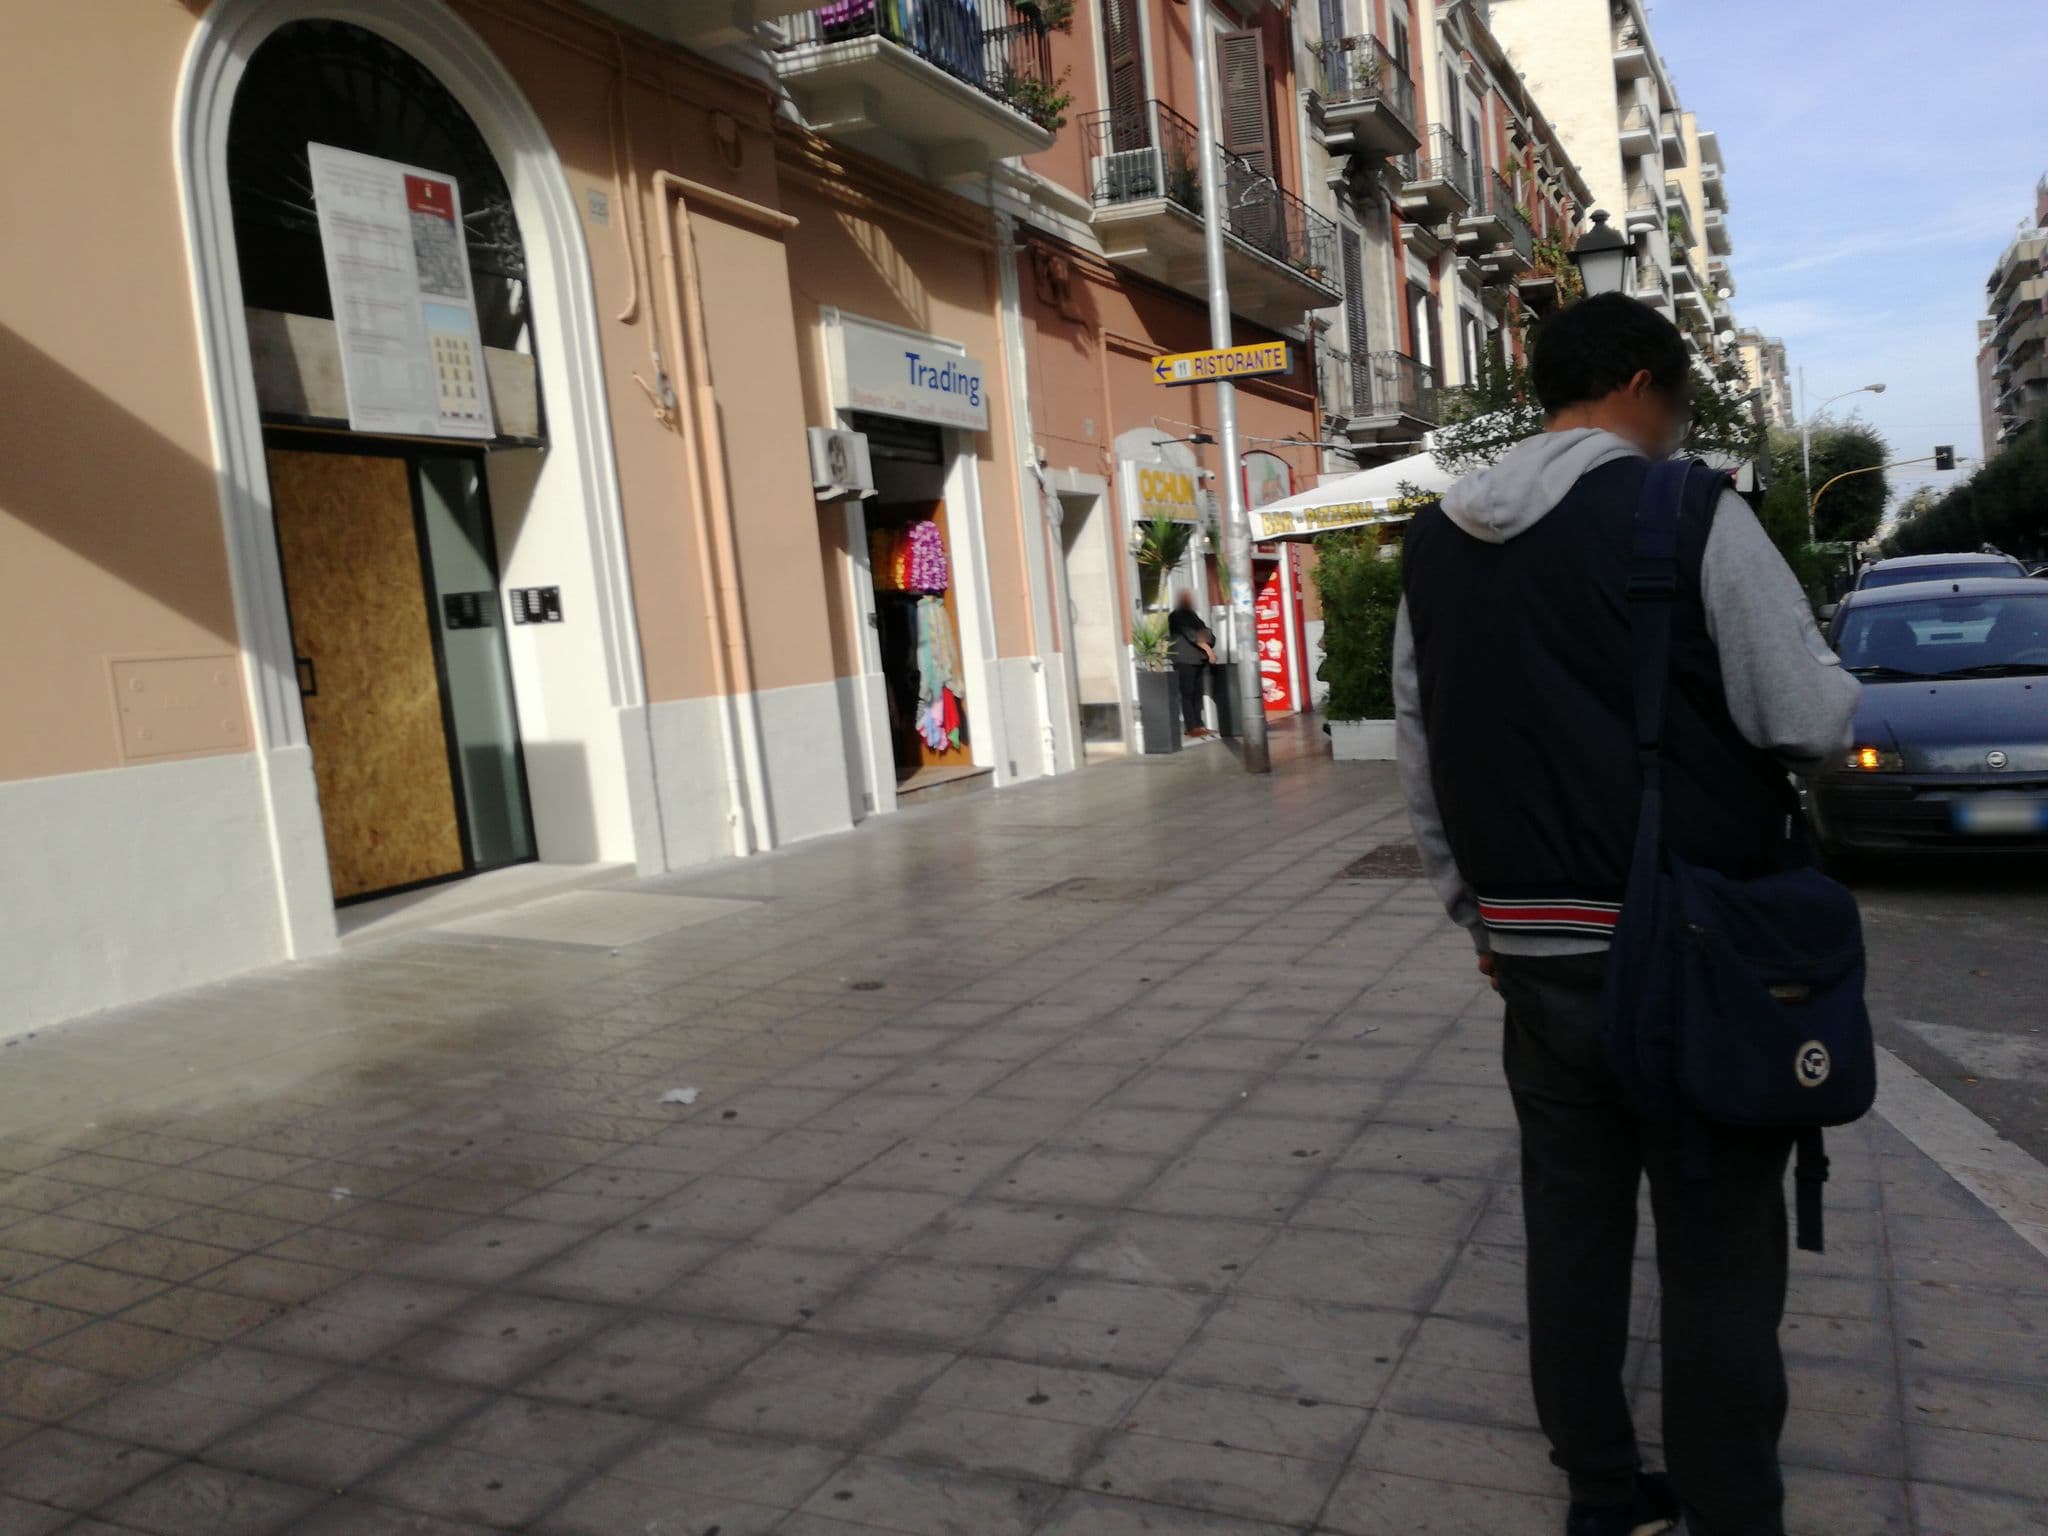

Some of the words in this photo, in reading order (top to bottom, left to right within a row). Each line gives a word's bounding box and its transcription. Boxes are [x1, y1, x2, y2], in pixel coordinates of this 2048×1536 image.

[1194, 347, 1282, 377] RISTORANTE
[905, 351, 980, 407] Trading
[1261, 510, 1296, 536] BAR
